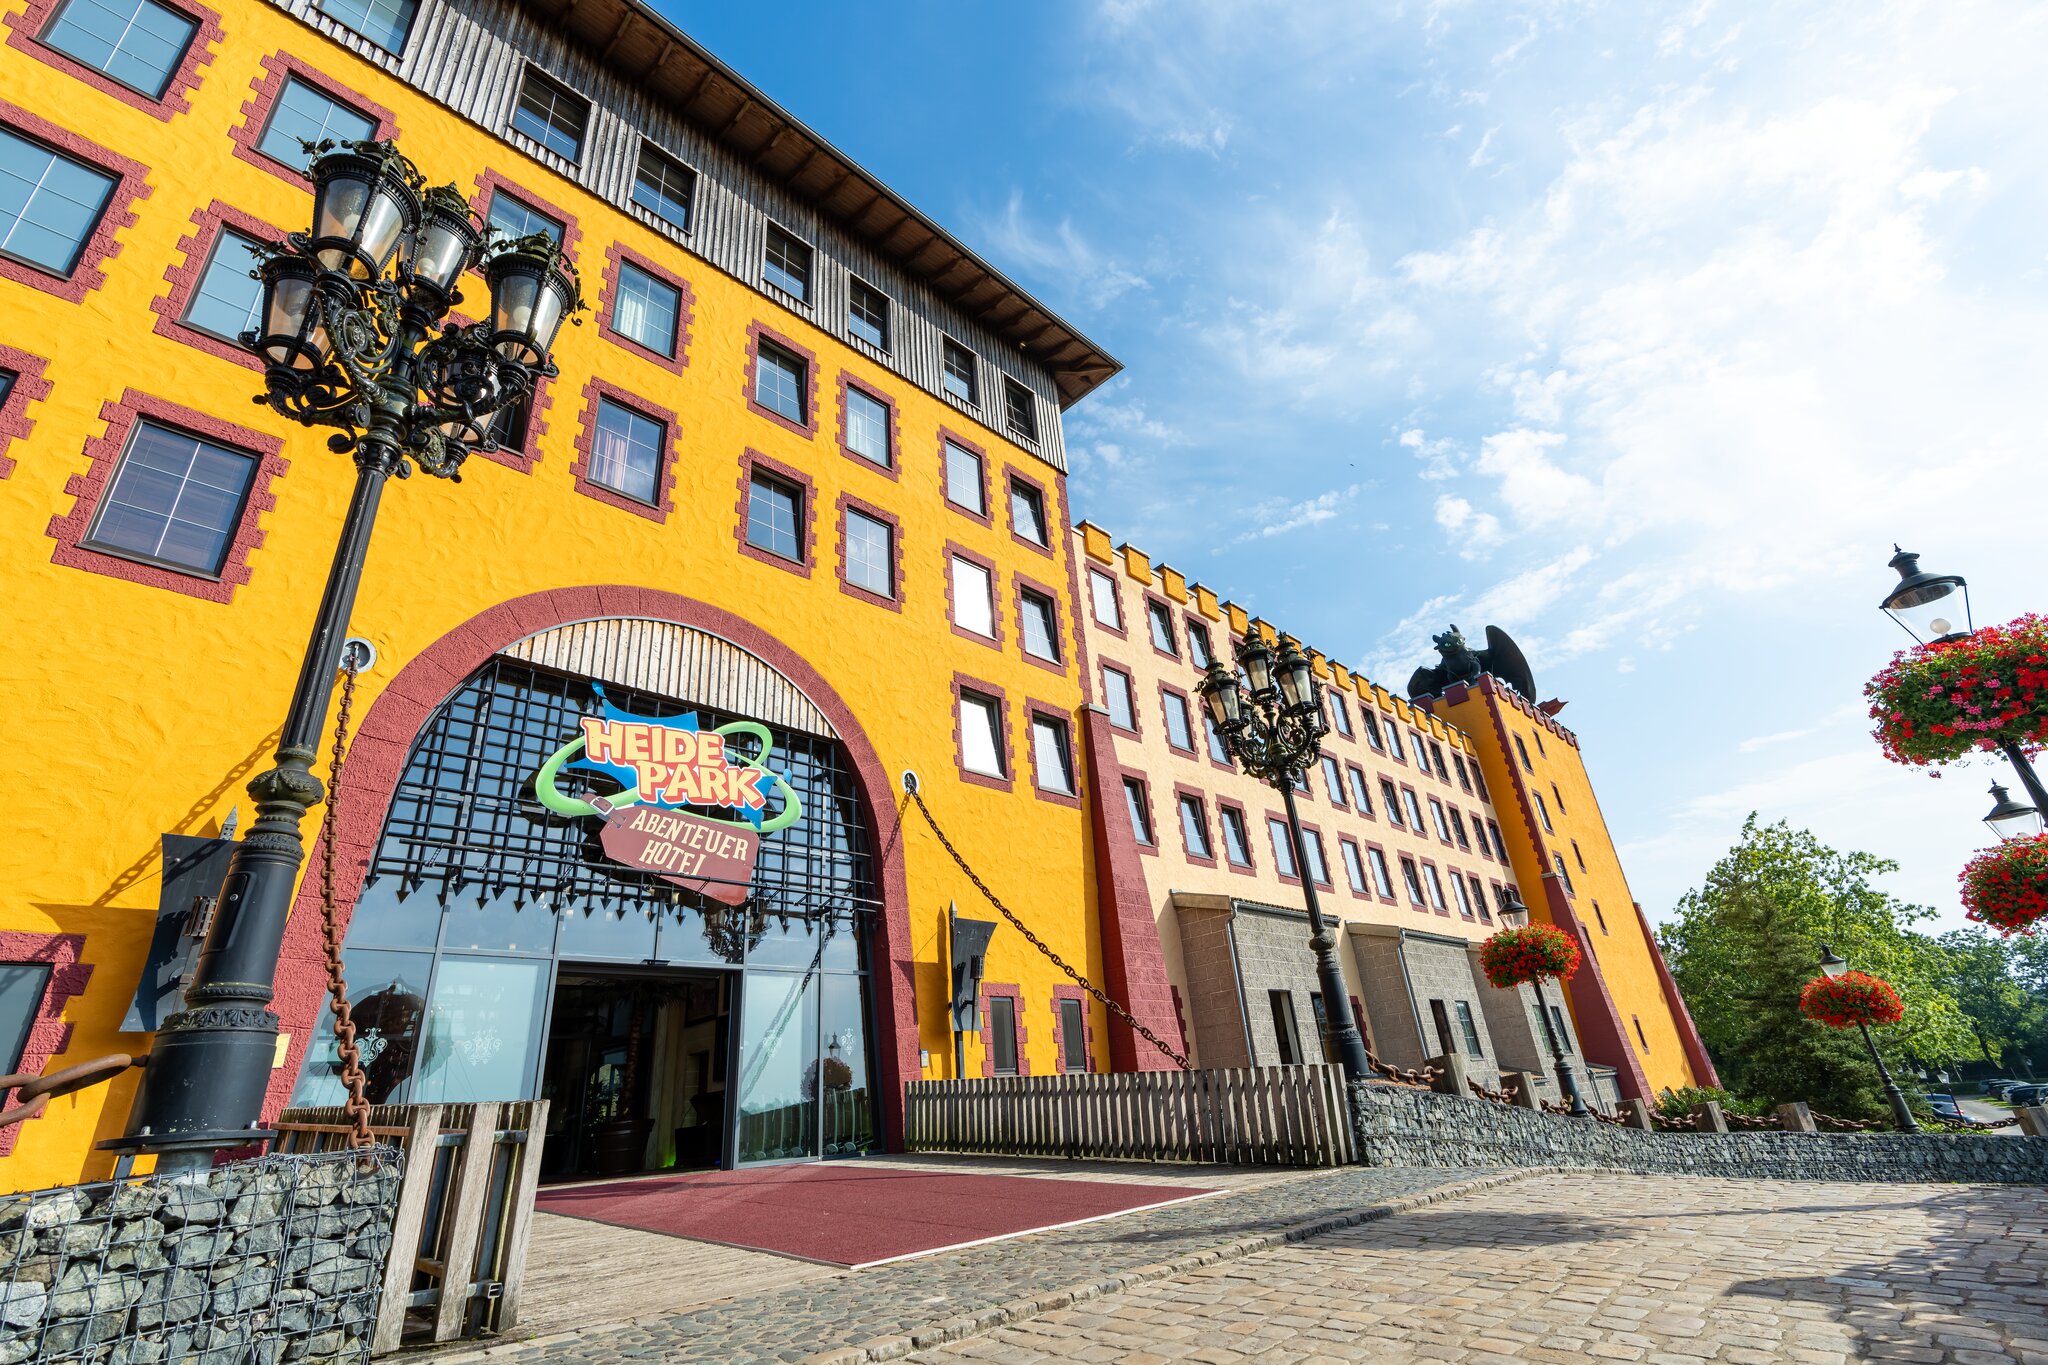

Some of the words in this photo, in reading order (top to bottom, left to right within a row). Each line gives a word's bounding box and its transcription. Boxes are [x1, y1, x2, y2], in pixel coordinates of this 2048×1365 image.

[582, 718, 724, 767] HEIDE
[637, 761, 765, 808] PARK
[629, 809, 749, 861] ABENTEUER
